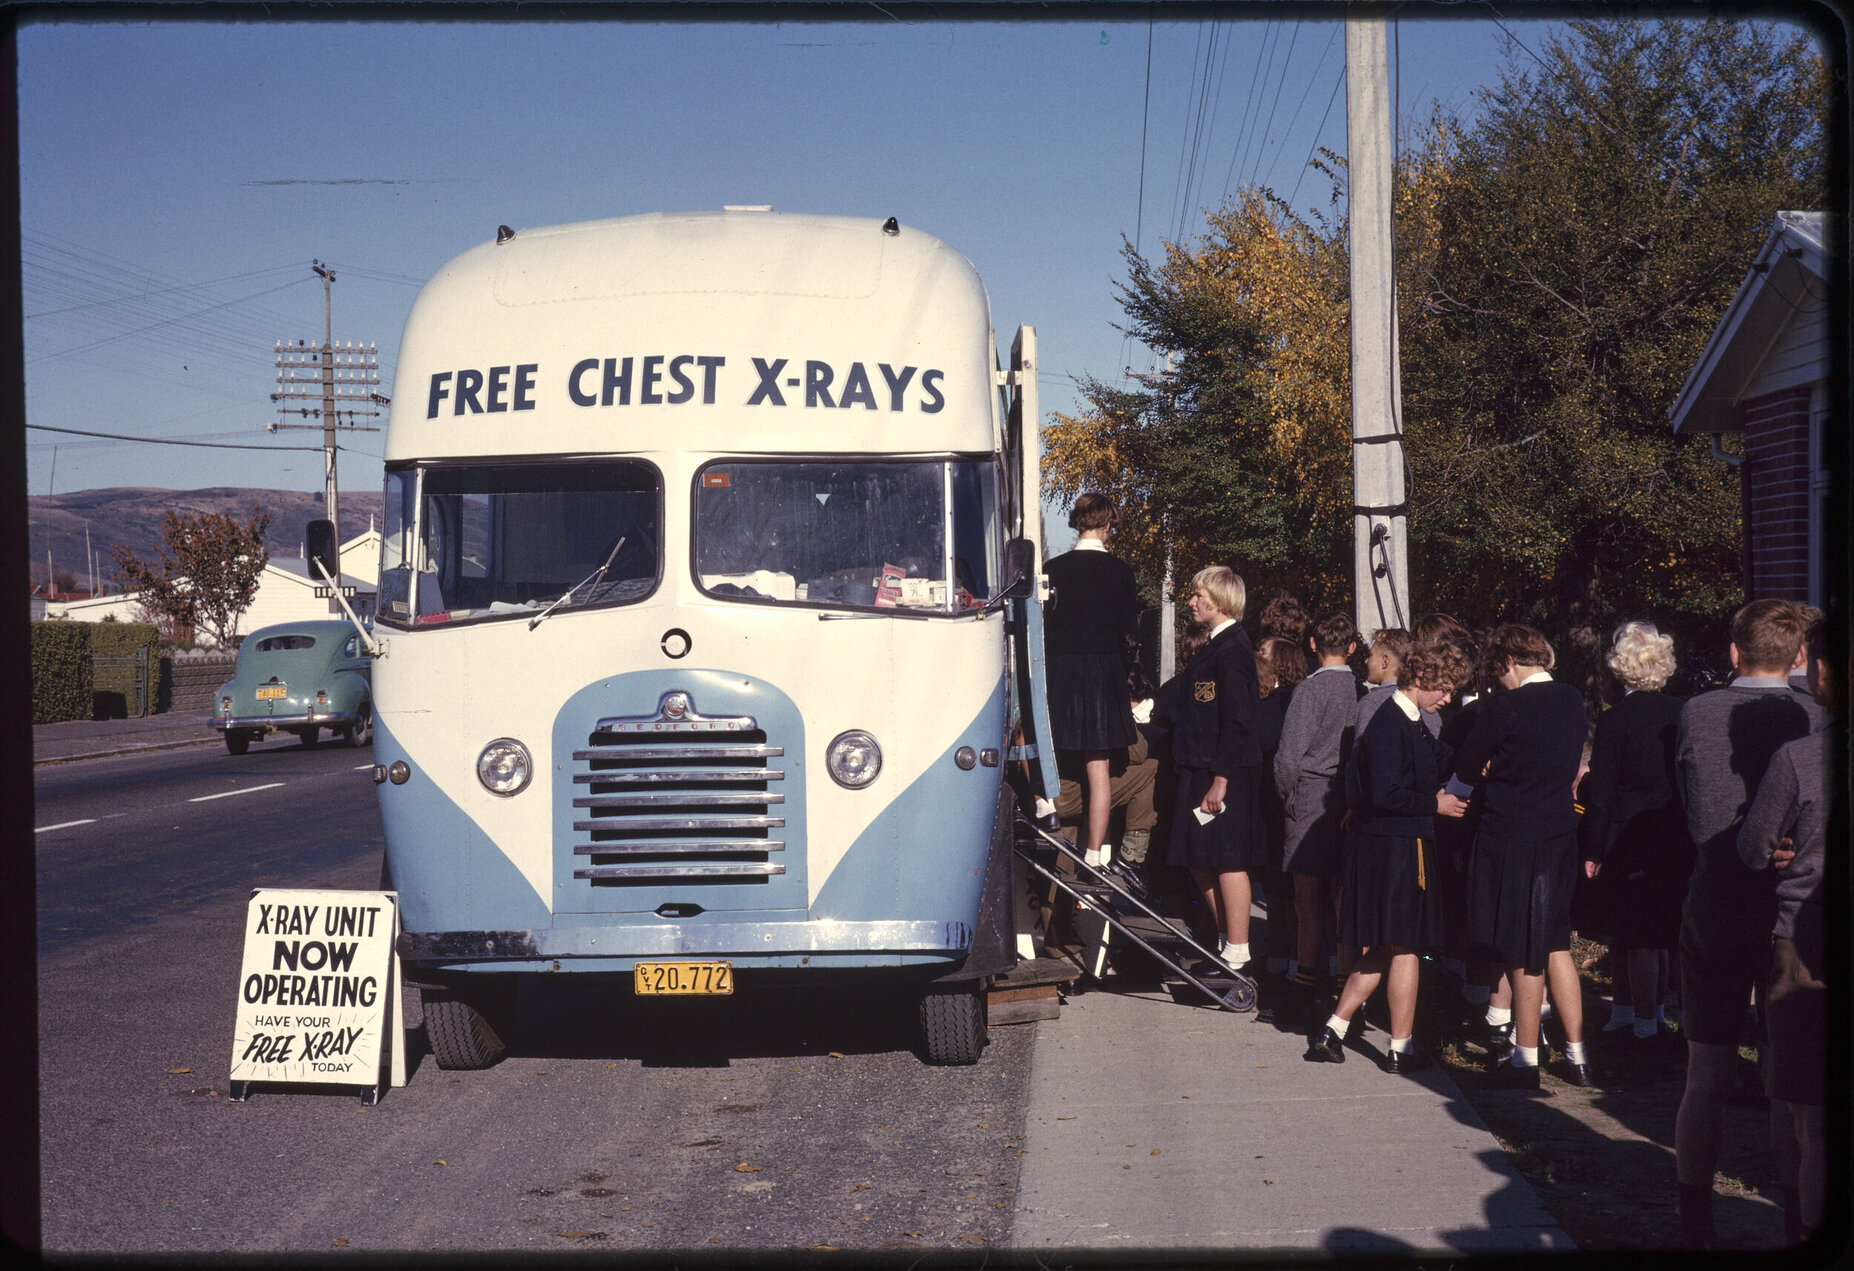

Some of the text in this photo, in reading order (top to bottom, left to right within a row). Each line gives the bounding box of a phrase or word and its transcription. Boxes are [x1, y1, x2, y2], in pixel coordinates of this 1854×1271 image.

[426, 355, 945, 419] FREE CHEST X-RAYS
[618, 722, 734, 730] BEDFORD
[325, 906, 381, 937] UNIT
[273, 941, 358, 972] NOW
[244, 974, 377, 1007] OPERATING
[654, 966, 728, 990] 20.772
[255, 1015, 331, 1028] HAVE YOUR
[242, 1032, 296, 1063] FREE
[312, 1062, 353, 1073] TODAY
